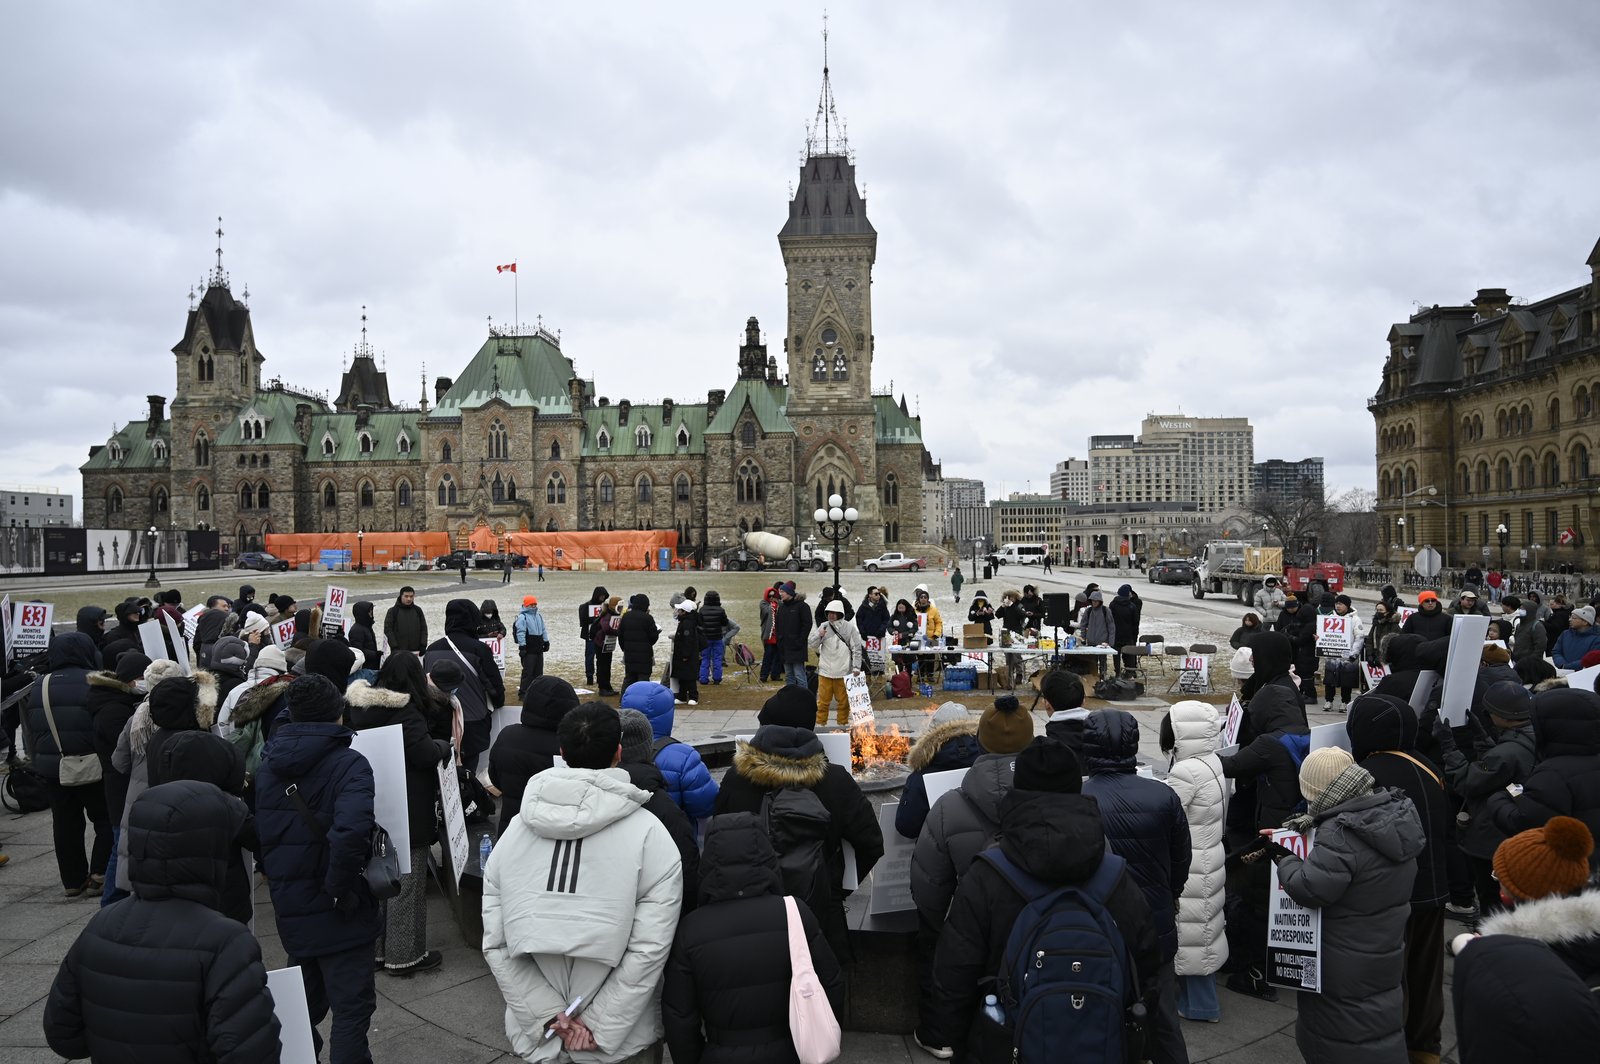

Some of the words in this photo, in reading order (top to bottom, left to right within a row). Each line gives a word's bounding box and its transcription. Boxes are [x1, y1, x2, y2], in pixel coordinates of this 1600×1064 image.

[331, 589, 343, 607] 23
[24, 606, 45, 626] 33
[280, 621, 295, 641] 32
[1325, 618, 1343, 633] 22
[867, 638, 880, 650] 33
[1187, 658, 1201, 670] 40
[1369, 666, 1384, 678] 25
[1274, 913, 1297, 926] WAITING
[1298, 914, 1310, 927] FOR
[1271, 929, 1282, 941] IRCC
[1282, 930, 1314, 944] RESPONSE
[1275, 952, 1281, 963] NO
[1276, 966, 1283, 977] NO
